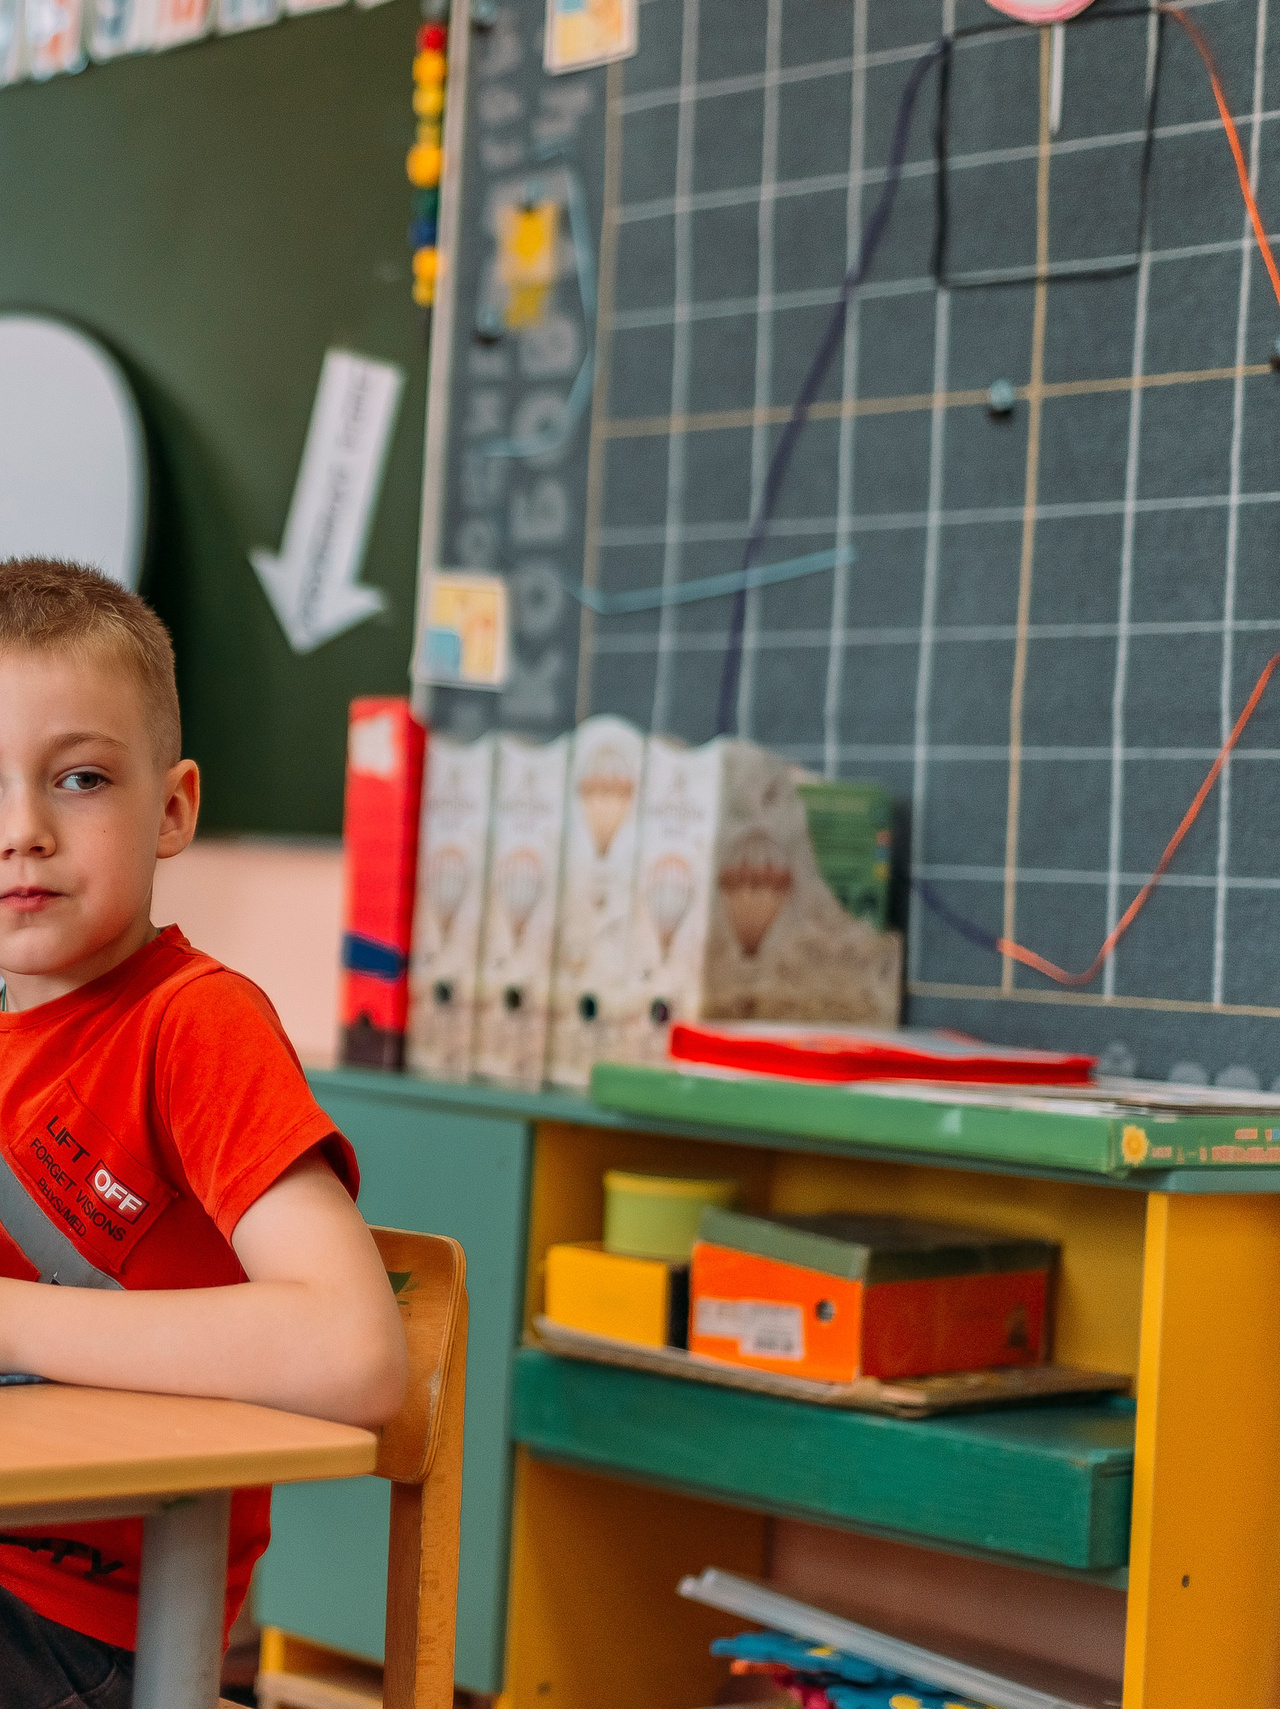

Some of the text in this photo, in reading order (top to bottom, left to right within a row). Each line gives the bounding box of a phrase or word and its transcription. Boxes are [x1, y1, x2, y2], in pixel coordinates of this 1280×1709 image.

[29, 1137, 127, 1242] FORGET VISIONS
[37, 1176, 87, 1238] PHYS/MED
[45, 1115, 143, 1212] LIFT OFF
